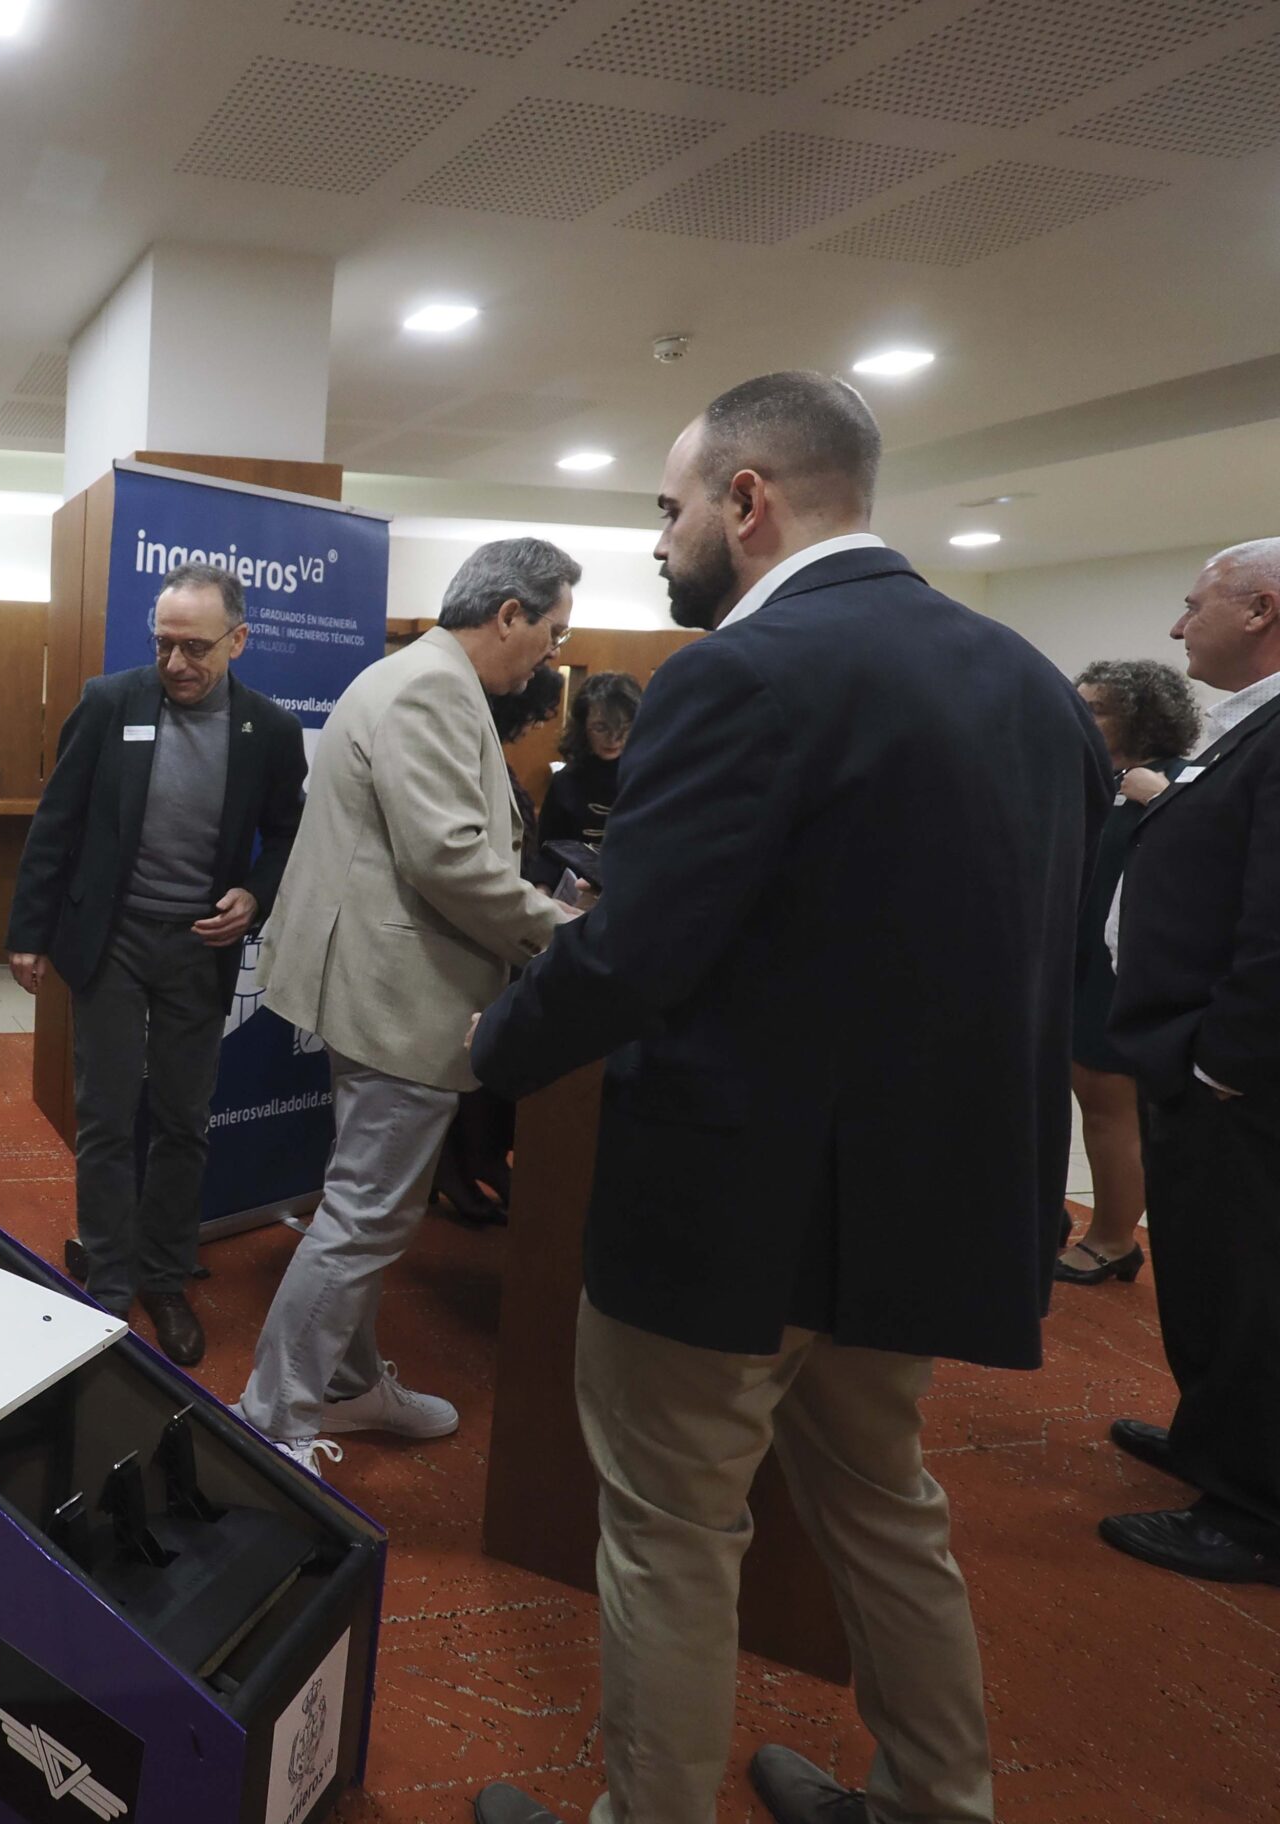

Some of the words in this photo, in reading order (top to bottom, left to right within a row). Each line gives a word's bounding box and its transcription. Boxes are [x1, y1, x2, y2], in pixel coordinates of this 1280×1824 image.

[260, 607, 306, 625] GRADUADOS
[287, 627, 330, 643] INGENIEROS
[331, 630, 365, 646] TÉCNICOS
[205, 1091, 333, 1134] enierosvalladolid.es
